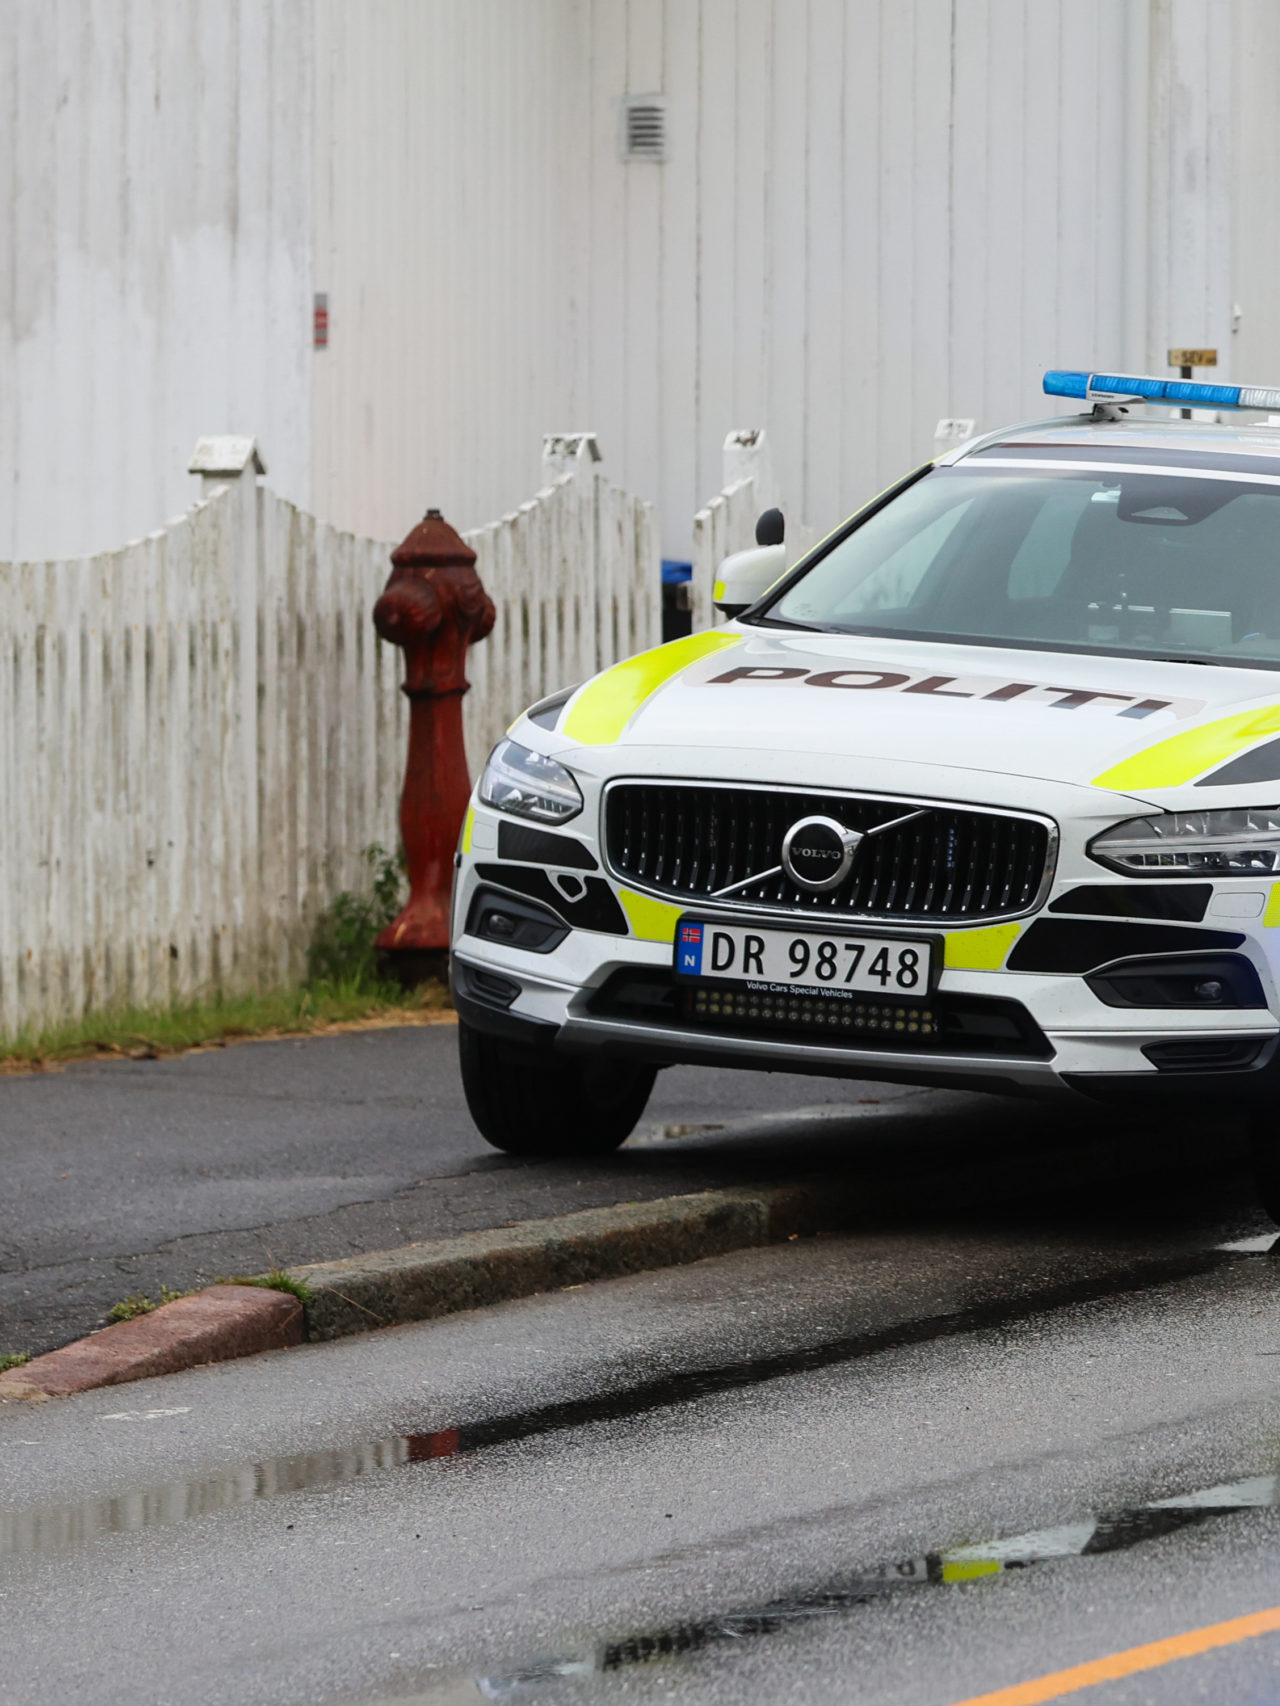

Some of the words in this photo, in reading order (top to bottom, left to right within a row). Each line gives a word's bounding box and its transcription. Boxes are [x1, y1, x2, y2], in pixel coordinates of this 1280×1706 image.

[705, 666, 1174, 720] POLITI
[791, 847, 842, 860] VOLVO
[684, 955, 695, 967] N
[711, 931, 765, 975] DR
[788, 938, 920, 988] 98748
[746, 981, 768, 991] Volvo
[769, 983, 788, 993] Cars
[789, 985, 819, 996] Special
[820, 987, 853, 999] Vehicles
